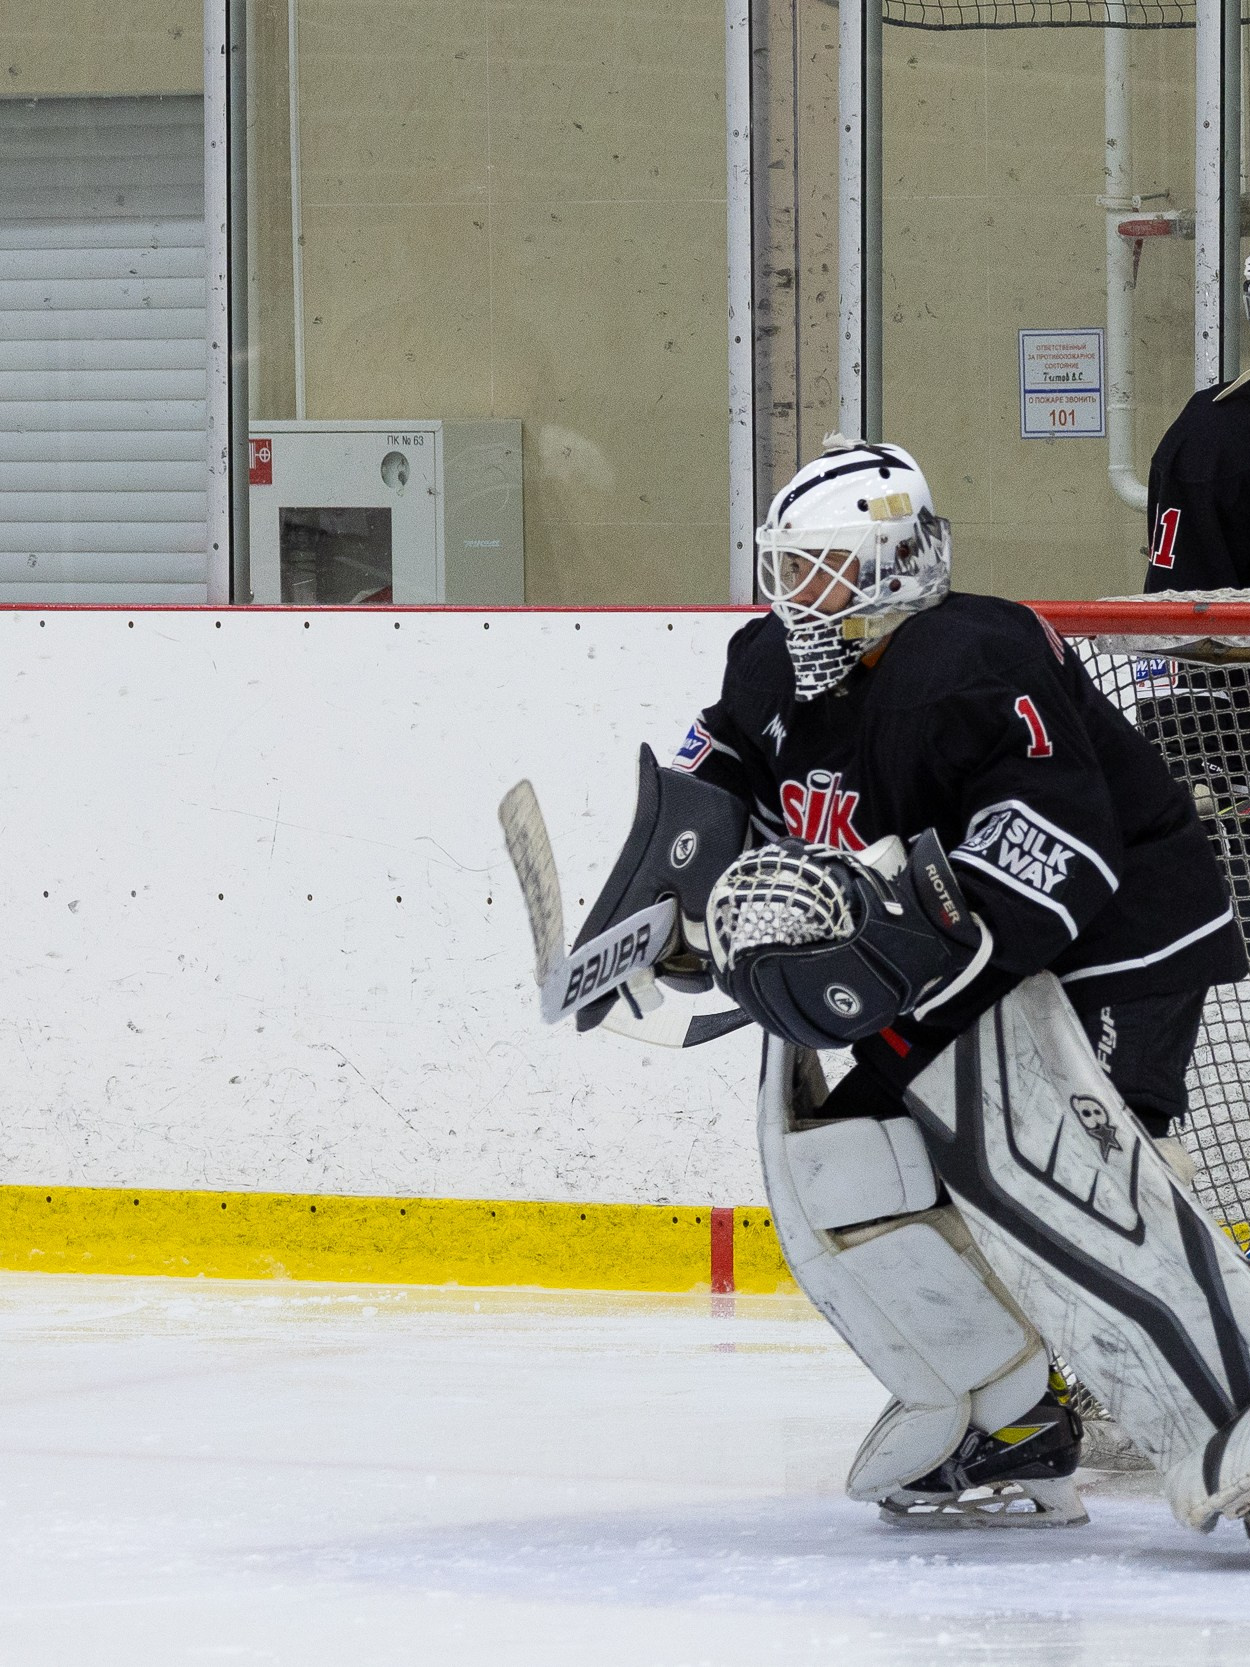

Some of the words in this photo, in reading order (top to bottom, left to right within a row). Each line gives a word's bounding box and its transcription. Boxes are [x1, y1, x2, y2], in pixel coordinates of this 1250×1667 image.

[1035, 396, 1063, 404] ПОЖАРЕ
[1065, 395, 1097, 403] ЗВОНИТЬ
[1049, 409, 1076, 426] 101
[387, 436, 400, 446] ПК
[402, 436, 412, 446] №
[413, 435, 424, 446] 63
[1014, 695, 1052, 758] 1
[998, 838, 1067, 894] WAY
[1005, 817, 1076, 876] SILK
[924, 863, 960, 925] RIOTER
[561, 923, 650, 1011] BAUER
